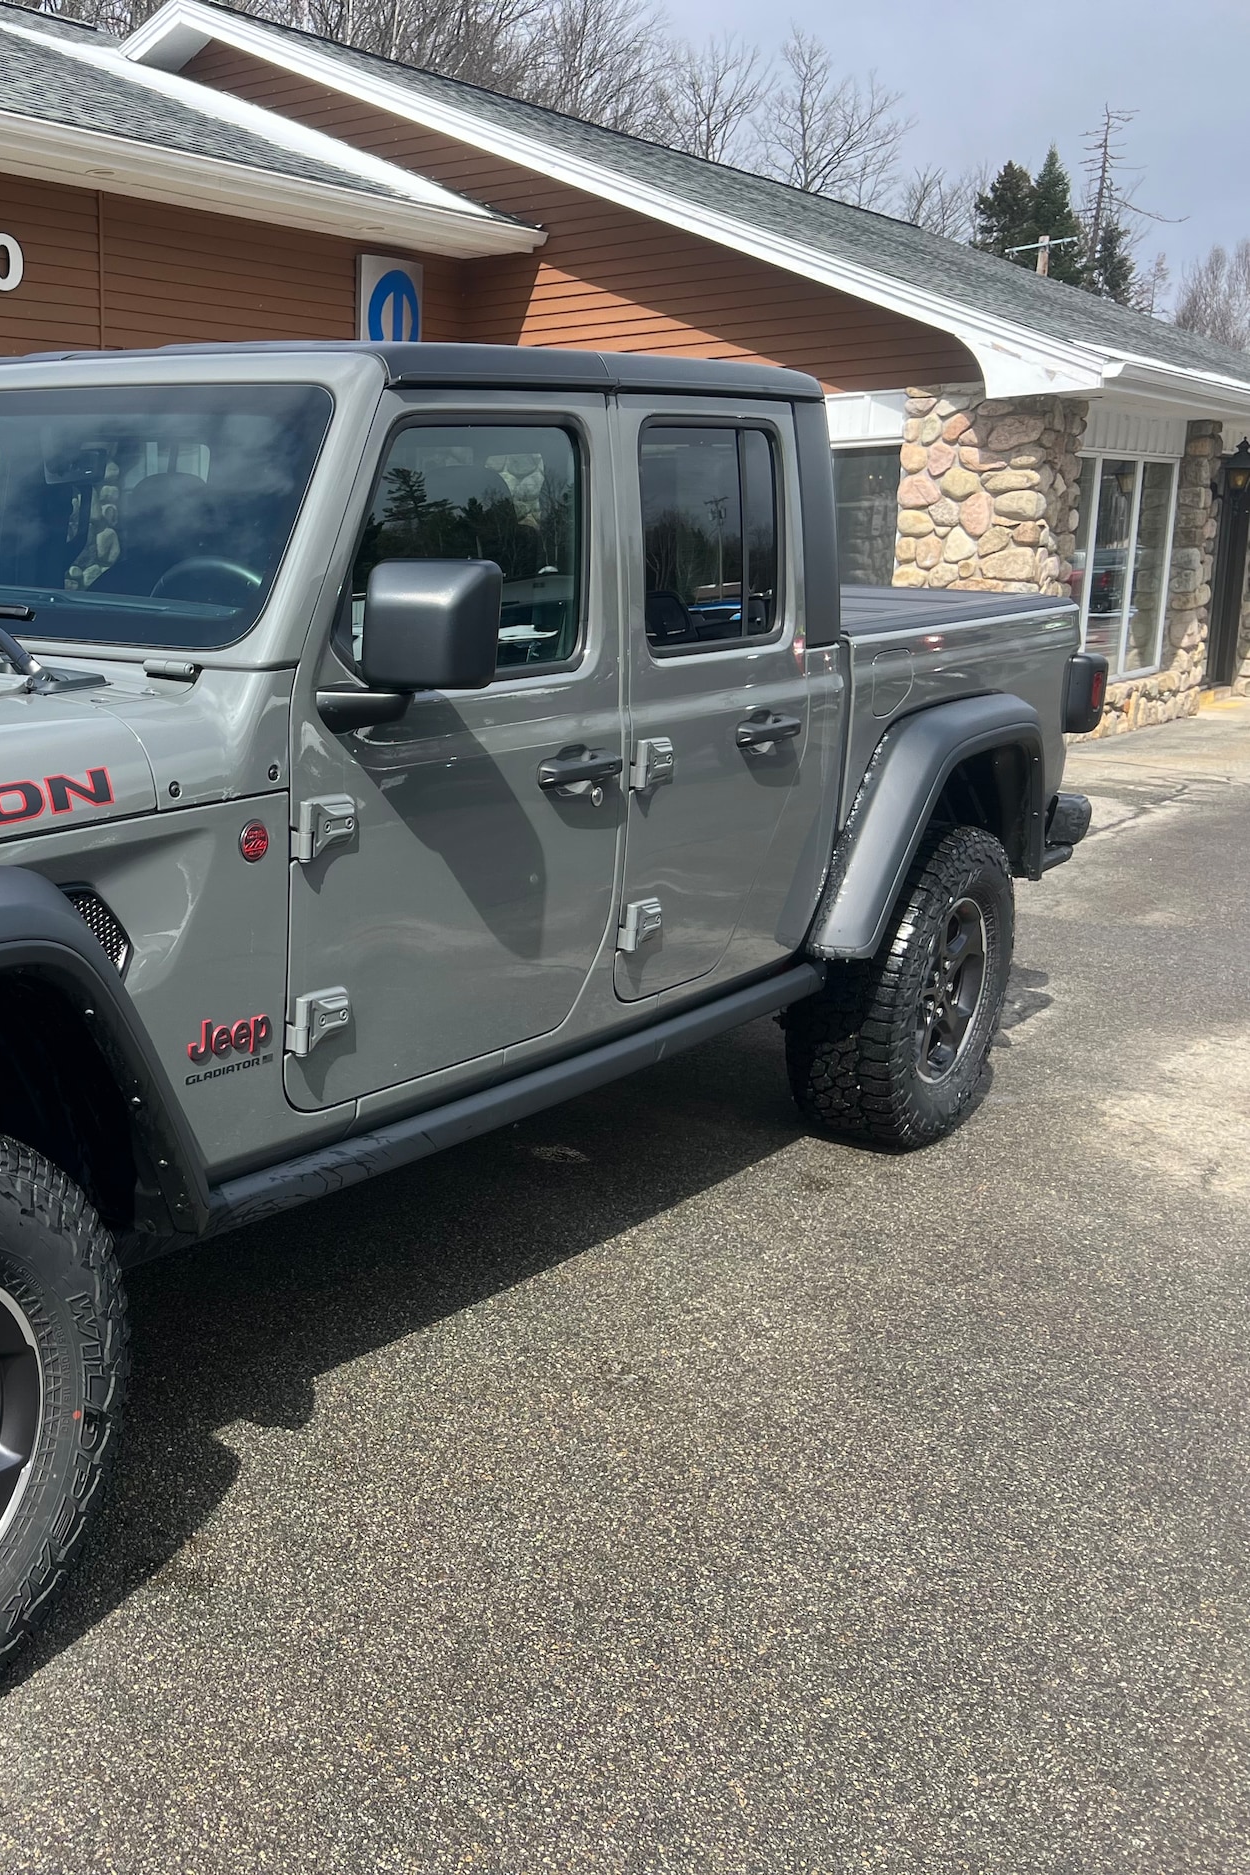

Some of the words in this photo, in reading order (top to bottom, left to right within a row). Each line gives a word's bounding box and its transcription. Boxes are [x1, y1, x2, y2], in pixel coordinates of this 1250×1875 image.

[187, 1013, 271, 1062] Jeep
[185, 1057, 261, 1086] GLADIATOR
[2, 1291, 106, 1634] WILDPEAK
